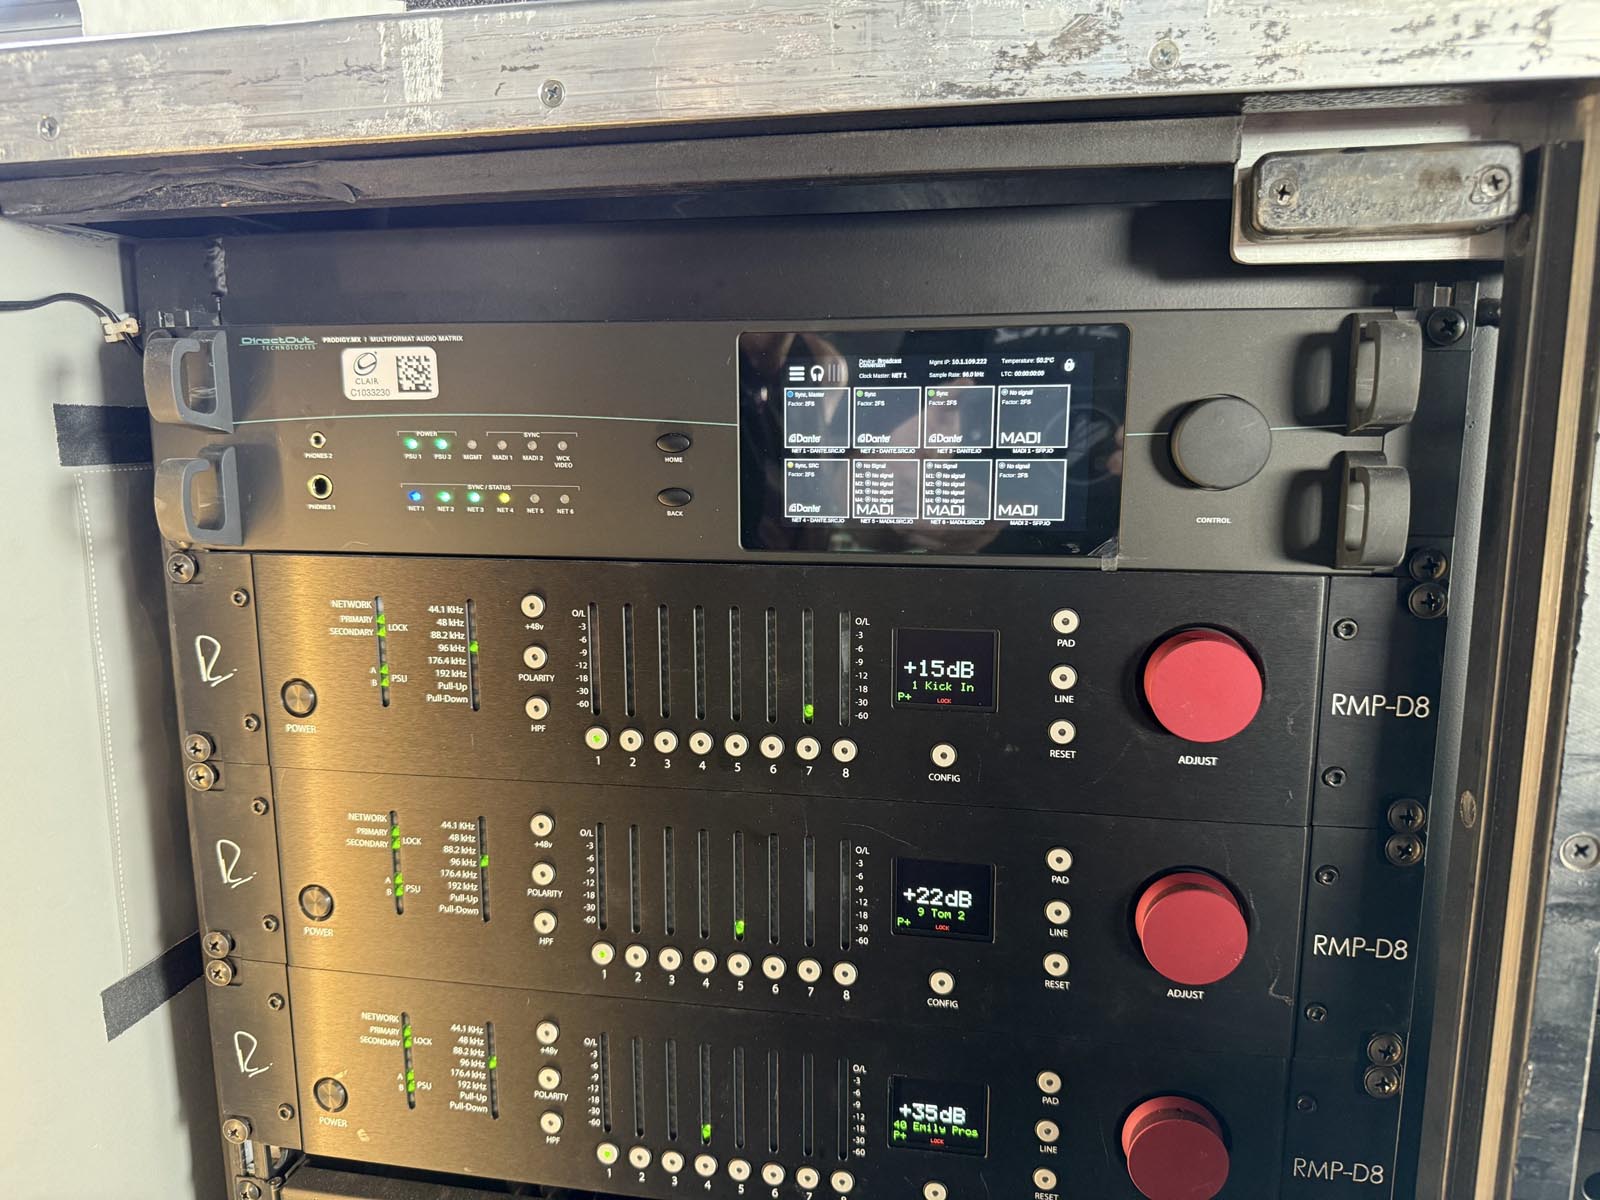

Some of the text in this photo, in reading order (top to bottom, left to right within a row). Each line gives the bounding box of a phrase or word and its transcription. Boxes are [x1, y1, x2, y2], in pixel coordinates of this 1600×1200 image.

[241, 336, 315, 345] DirectOut
[350, 389, 390, 397] C1033230
[797, 434, 821, 442] Dante
[866, 434, 891, 442] Dante
[936, 434, 962, 443] Dante
[1001, 432, 1041, 444] MADI
[797, 504, 820, 512] Dante
[856, 504, 894, 515] MADI
[927, 505, 965, 516] MADI
[998, 505, 1038, 516] MADI
[1196, 516, 1232, 524] CONTROL
[331, 600, 372, 609] NETWORK
[447, 606, 464, 615] KHz
[572, 609, 586, 618] O/L
[340, 615, 373, 624] PRIMARY
[436, 618, 464, 627] 48 kHz
[855, 617, 870, 626] O/L
[388, 624, 408, 632] LOCK
[525, 623, 544, 631] +48v
[329, 628, 374, 636] SECONDARY
[430, 631, 465, 640] 88.2 kHz
[1056, 639, 1076, 648] PAD
[450, 644, 466, 653] kHz
[855, 644, 864, 653] -6
[428, 656, 466, 666] 176.4 kHz
[855, 658, 864, 666] -9
[435, 669, 467, 678] 192 kHz
[904, 659, 975, 679] +15dB
[392, 675, 408, 683] PSU
[518, 673, 555, 682] POLARITY
[855, 672, 868, 680] -12
[438, 682, 468, 692] Pull-Up
[912, 680, 975, 692] 1 Kick In
[426, 694, 469, 704] Pull-Down
[898, 692, 912, 701] P+
[1054, 694, 1075, 704] LINE
[855, 698, 868, 707] -30
[1331, 693, 1430, 719] RMP-D8
[855, 712, 869, 720] -60
[286, 724, 317, 733] POWER
[1049, 749, 1076, 759] RESET
[1177, 755, 1218, 767] ADJUST
[595, 755, 850, 778] 1 2 3 4 5 6 7 8
[928, 772, 960, 783] CONFIG
[1051, 875, 1070, 885] PAD
[903, 886, 972, 908] +22dB
[917, 907, 965, 921] 9 Tom 2
[897, 917, 911, 927] P+
[1048, 928, 1069, 938] LINE
[1313, 934, 1408, 961] RMP-D8
[1044, 979, 1070, 990] RESET
[1166, 988, 1205, 1000] ADJUST
[927, 998, 958, 1009] CONFIG
[1042, 1096, 1059, 1106] PAD
[899, 1102, 966, 1124] +35dB
[893, 1120, 979, 1138] 40 Emily Pros
[893, 1130, 907, 1141] P+
[1039, 1145, 1058, 1154] LINE
[1293, 1157, 1384, 1185] RMP-D8
